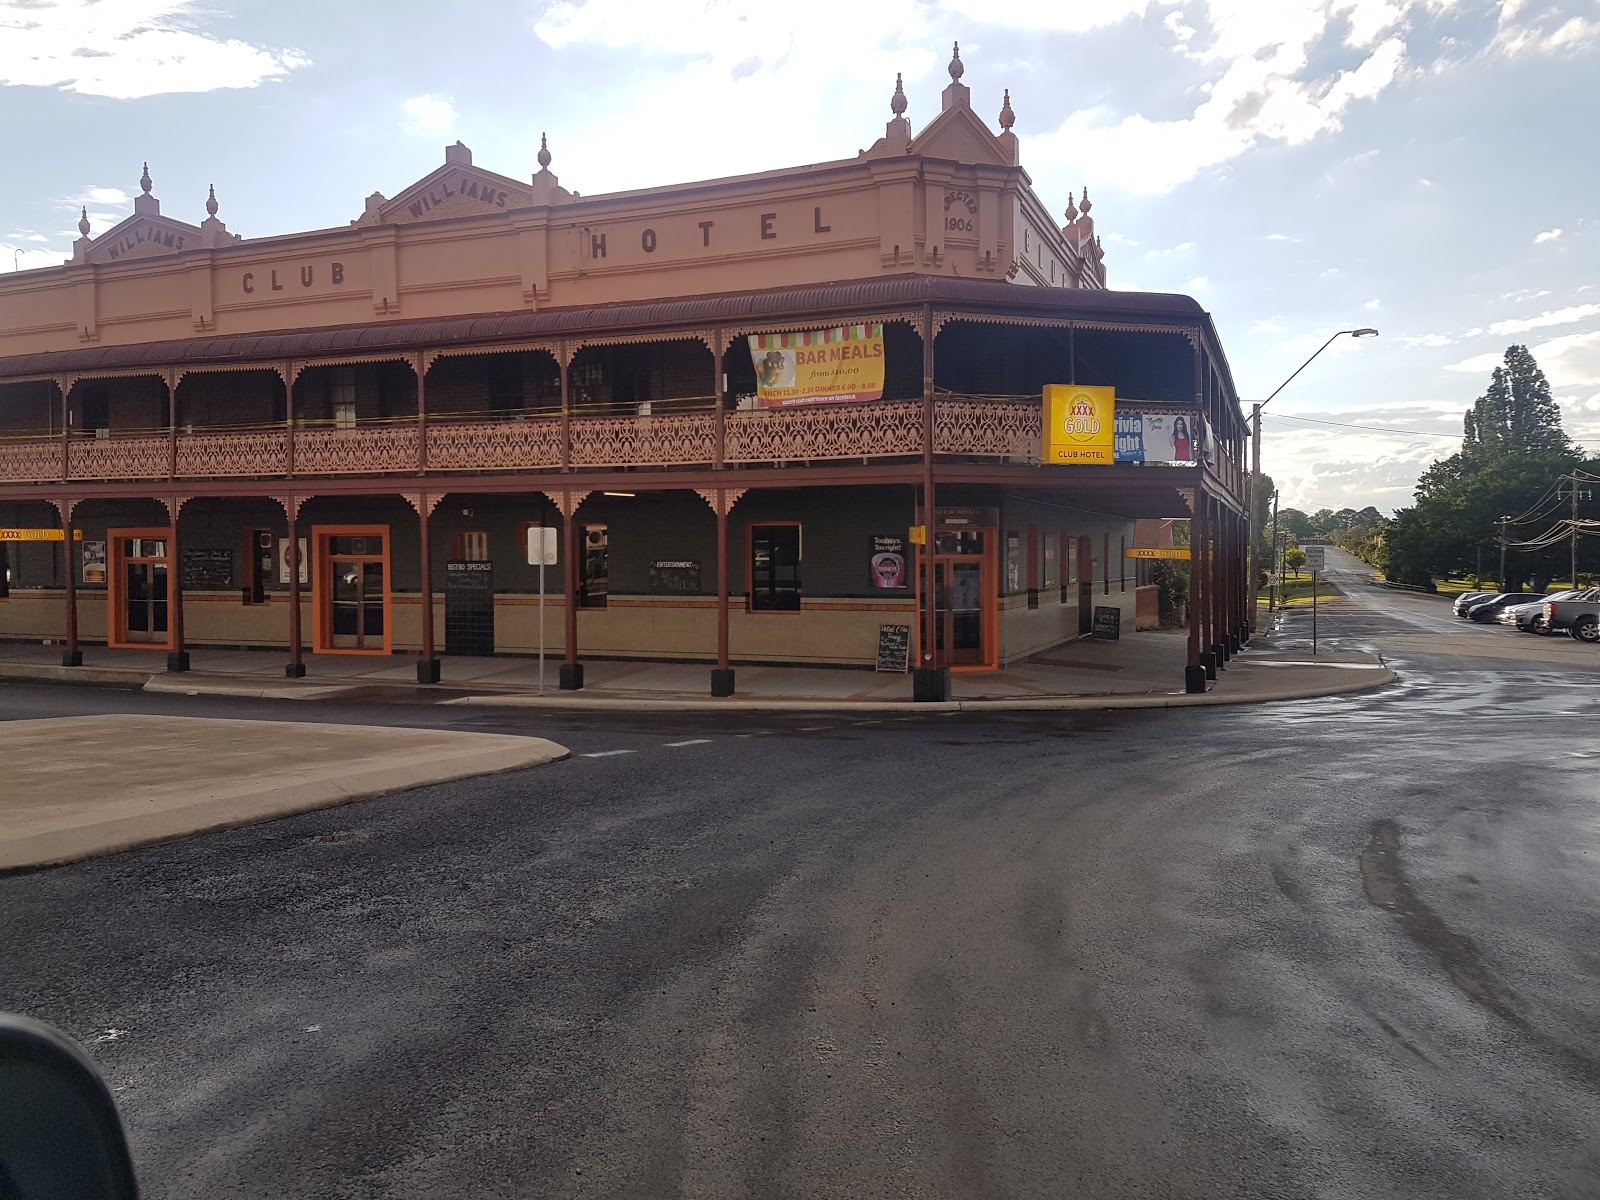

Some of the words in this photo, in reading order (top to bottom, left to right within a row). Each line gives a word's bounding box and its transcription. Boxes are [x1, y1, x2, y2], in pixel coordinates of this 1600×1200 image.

[408, 179, 507, 218] WILLIAMS
[945, 217, 973, 231] 1906
[592, 207, 831, 259] HOTEL
[108, 227, 185, 259] WILLIAMS
[243, 262, 344, 294] CLUB
[796, 349, 827, 366] BAR
[830, 343, 883, 362] MEALS
[809, 370, 830, 380] from
[831, 367, 860, 376] $10.00
[815, 384, 841, 392] DINNER
[1070, 405, 1095, 416] XXXX
[1064, 417, 1101, 435] GOLD
[1114, 417, 1142, 433] rivia
[1114, 435, 1140, 452] ight
[1058, 450, 1078, 458] CLUB
[1080, 451, 1105, 459] HOTEL
[0, 530, 21, 539] XXXX
[24, 530, 49, 539] GOLD
[447, 563, 465, 571] BISTRO
[466, 563, 491, 571] SPECIALS
